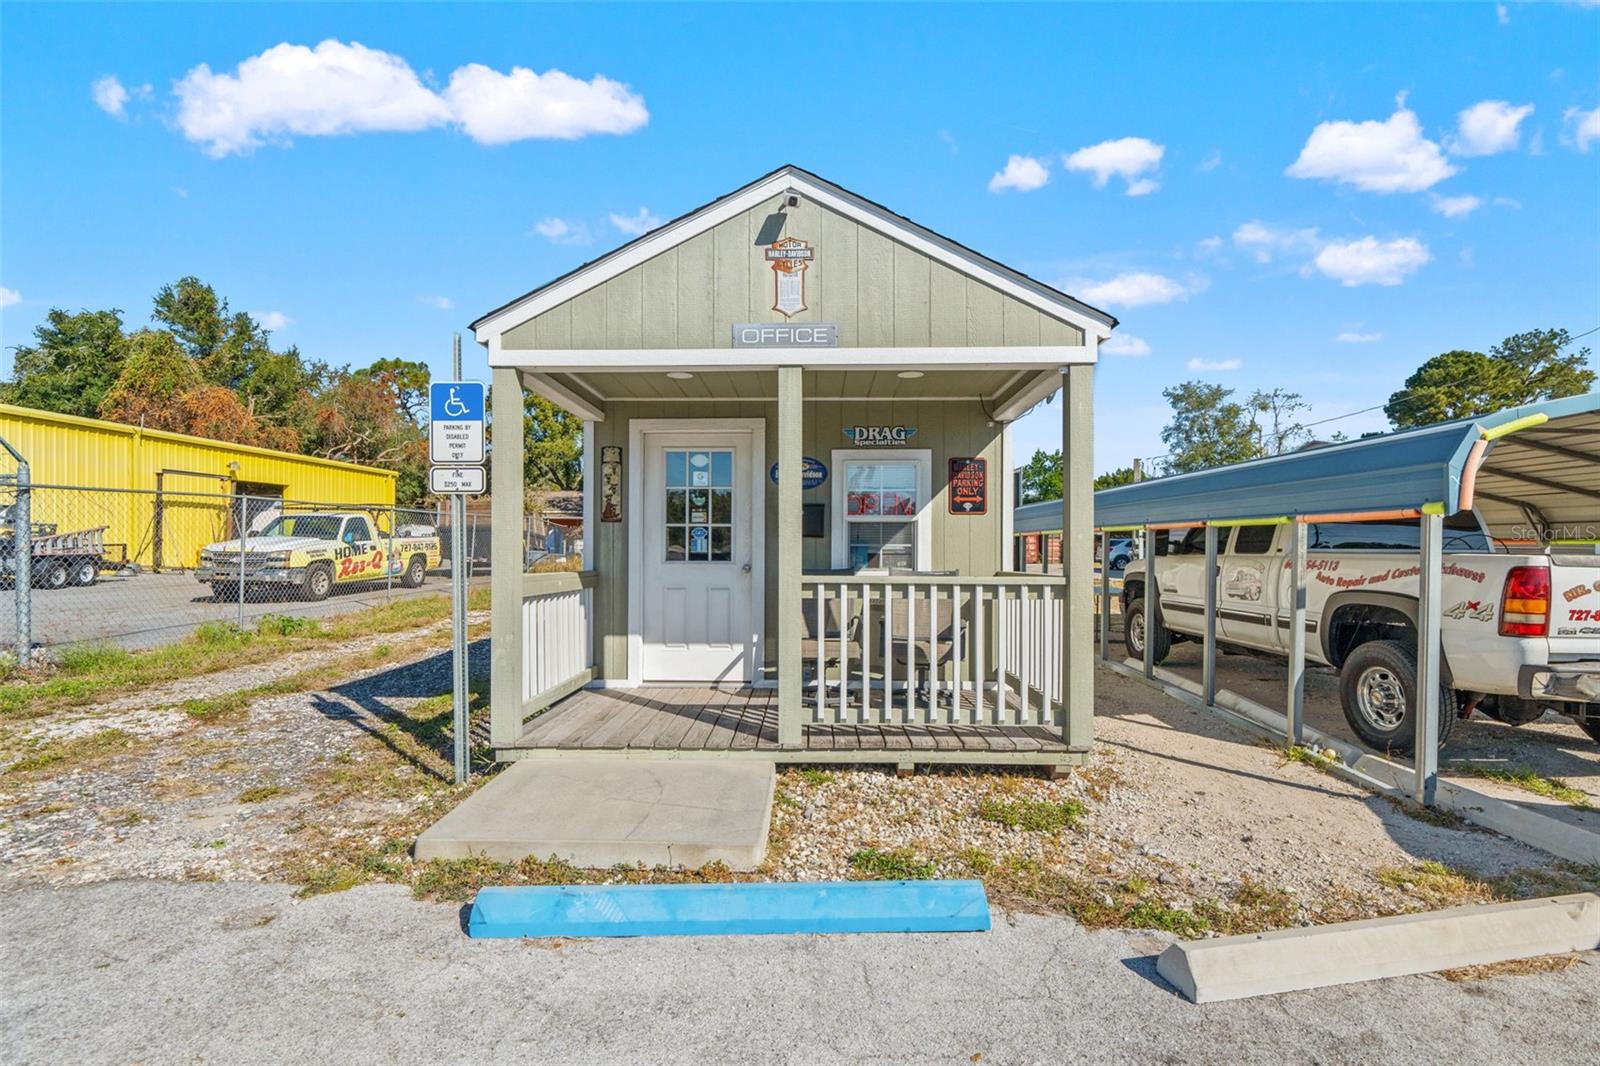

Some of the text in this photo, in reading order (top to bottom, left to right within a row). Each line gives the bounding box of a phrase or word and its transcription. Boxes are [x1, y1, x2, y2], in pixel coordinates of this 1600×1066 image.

[779, 241, 802, 249] MOTOR
[742, 328, 828, 343] OFFICE
[854, 426, 906, 440] DRAG
[957, 487, 979, 496] ONLY
[334, 544, 369, 560] HOME
[1315, 571, 1335, 586] Auto
[1336, 575, 1368, 588] Repair
[1368, 569, 1391, 584] and
